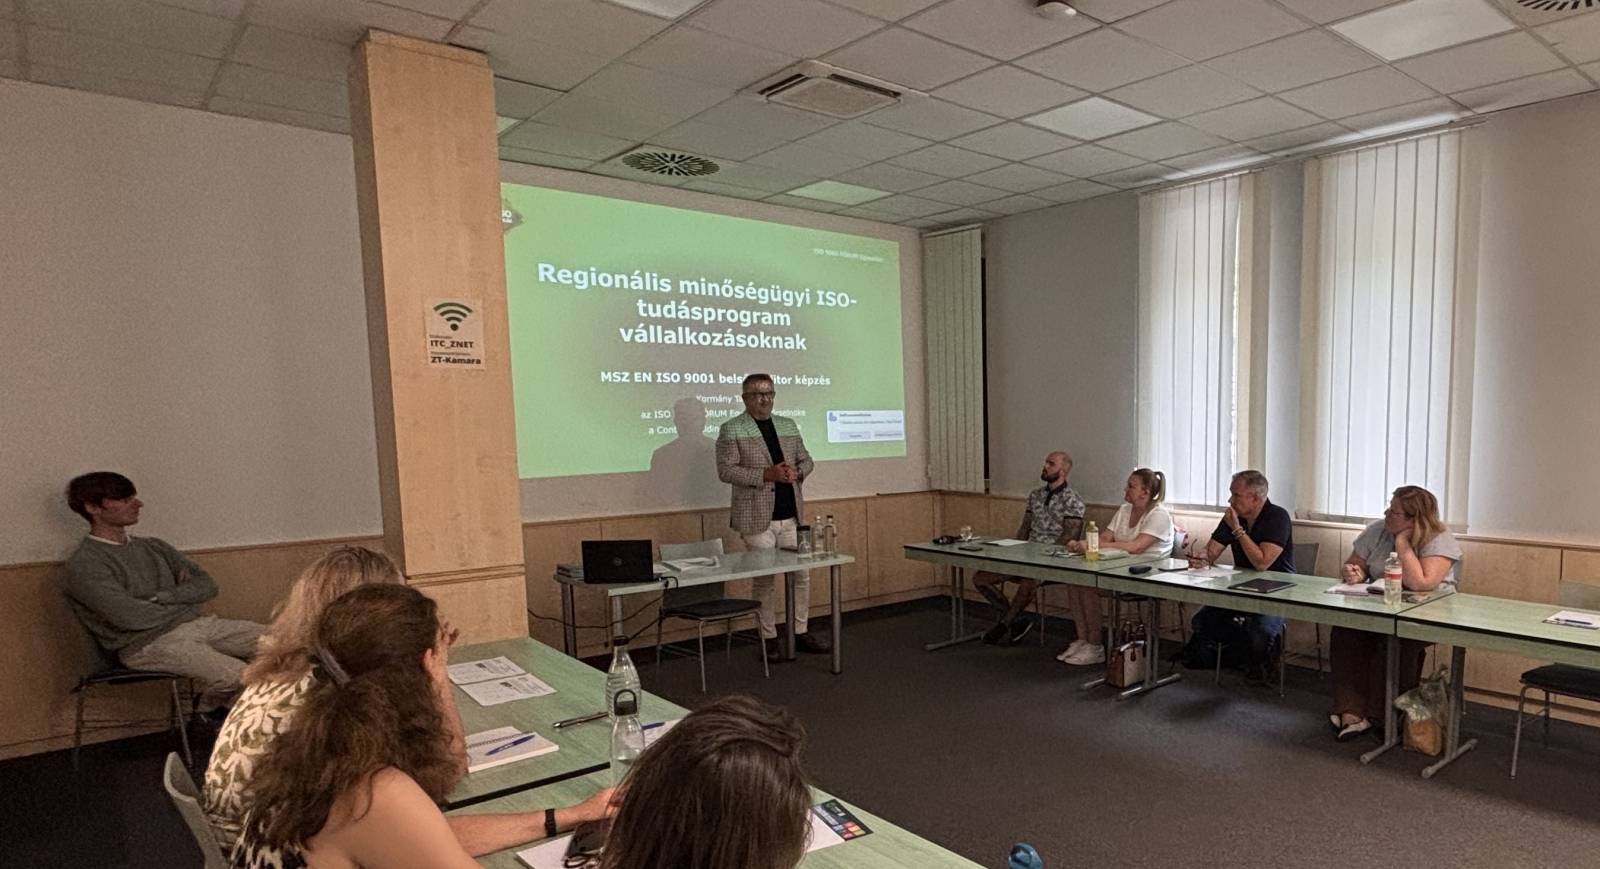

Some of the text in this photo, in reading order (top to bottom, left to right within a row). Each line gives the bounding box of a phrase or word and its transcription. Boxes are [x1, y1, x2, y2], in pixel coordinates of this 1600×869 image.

[537, 262, 857, 308] Regionális minőségügyi ISO-
[636, 299, 791, 327] tudásprogram
[430, 340, 474, 349] ITC_ZNET
[619, 323, 807, 350] vállalkozásoknak
[431, 356, 482, 364] ZT-Kamara
[600, 371, 630, 383] MSZ
[634, 371, 653, 383] EN
[656, 372, 681, 383] ISO
[684, 373, 716, 384] 9001
[795, 375, 831, 387] képzés
[654, 410, 671, 419] ISO
